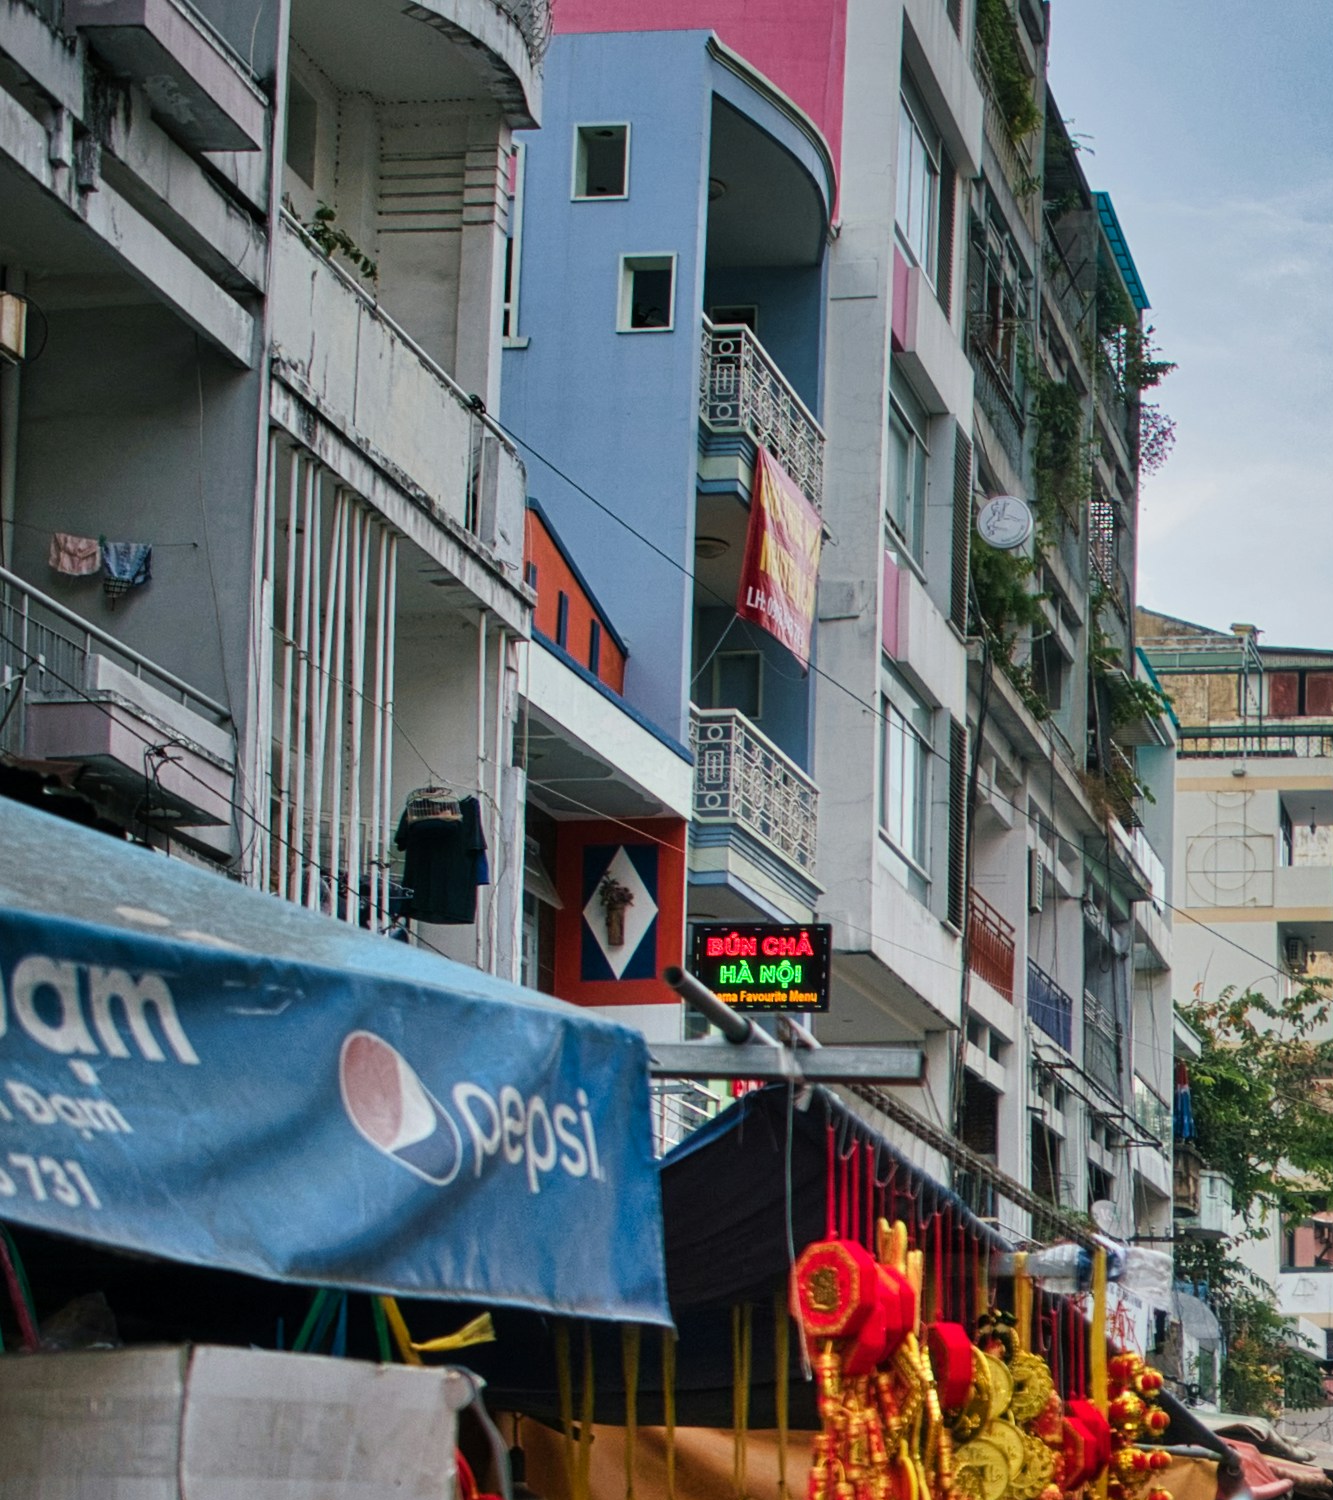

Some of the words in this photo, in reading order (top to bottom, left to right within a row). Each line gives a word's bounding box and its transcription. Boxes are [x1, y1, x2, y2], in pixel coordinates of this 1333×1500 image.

[706, 931, 757, 956] BÚN
[761, 931, 814, 956] CHẢ
[719, 959, 754, 984] HÀ
[759, 959, 802, 989] NỘI
[739, 990, 787, 1003] Favourite
[789, 990, 817, 1003] Menu
[452, 1080, 605, 1195] pepsi
